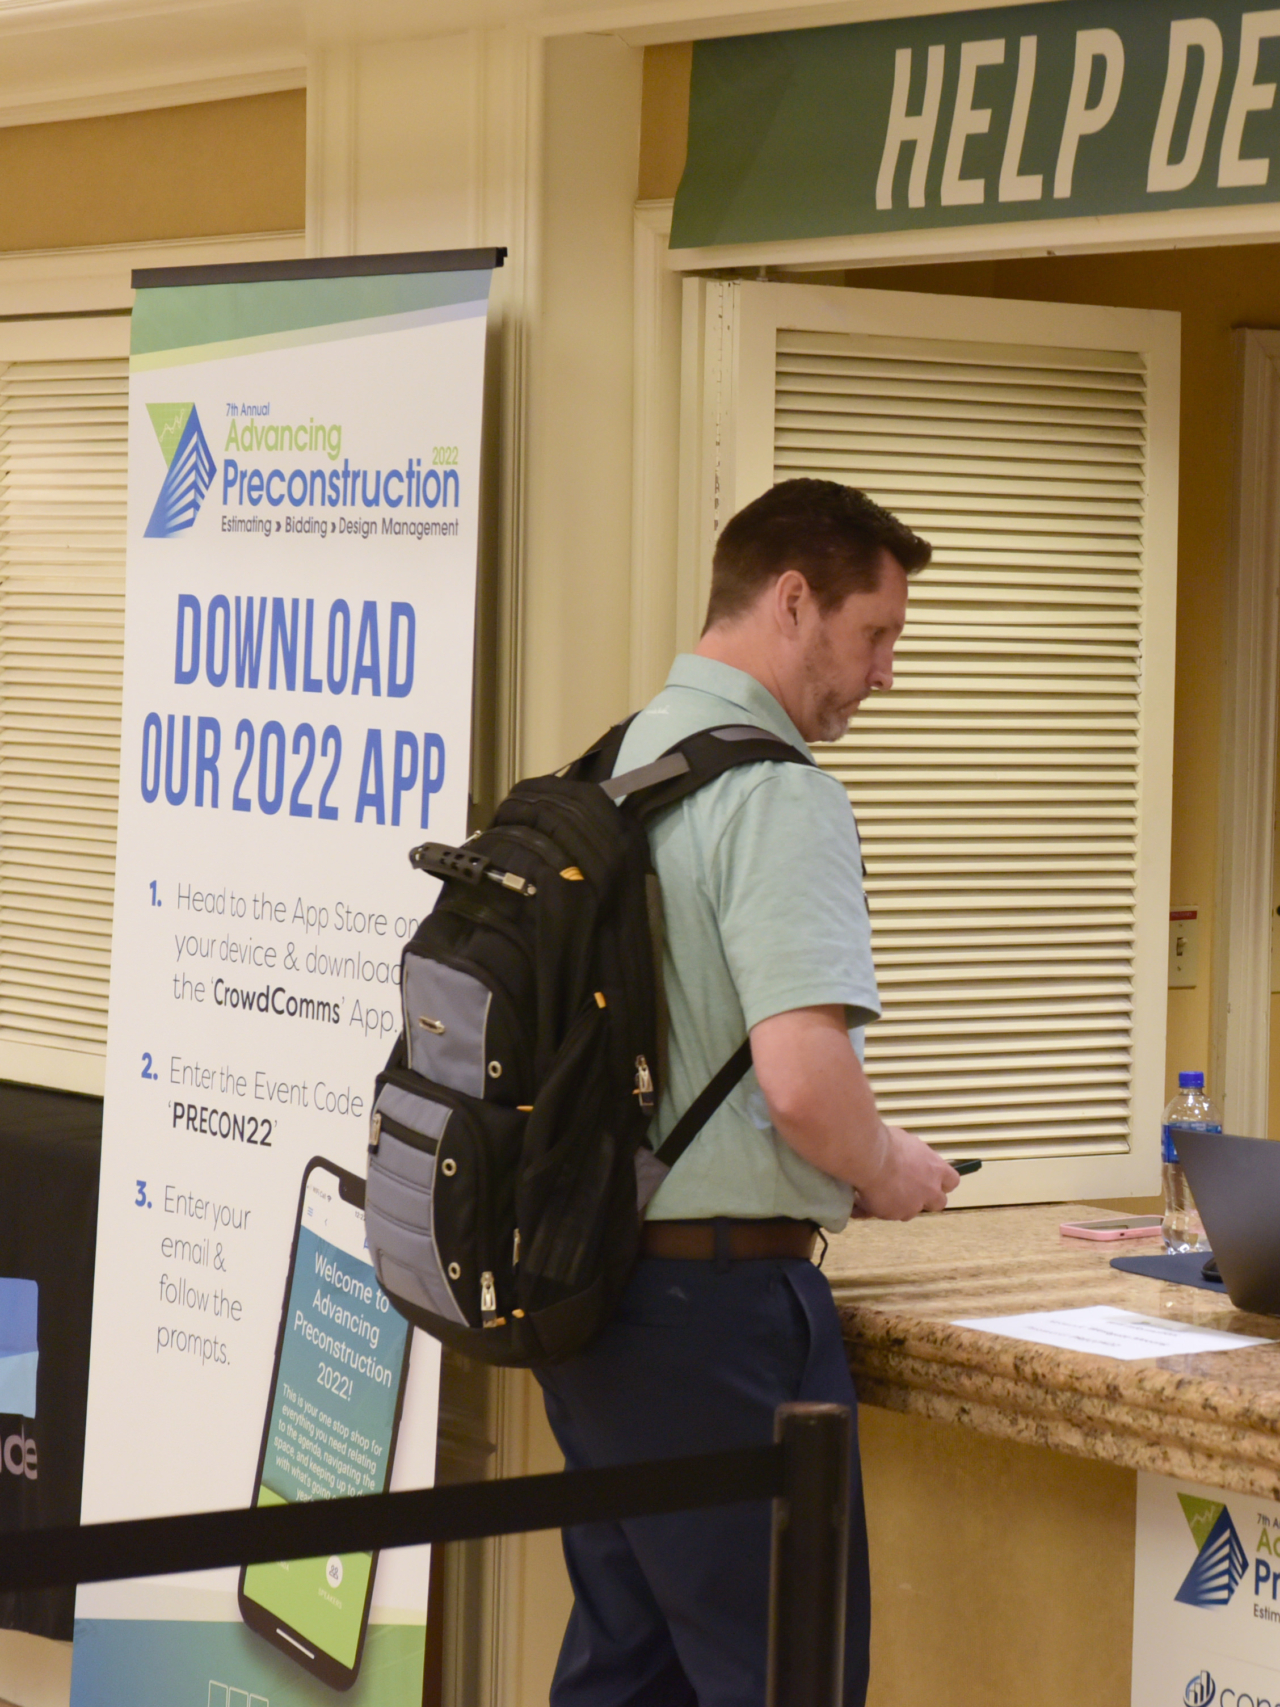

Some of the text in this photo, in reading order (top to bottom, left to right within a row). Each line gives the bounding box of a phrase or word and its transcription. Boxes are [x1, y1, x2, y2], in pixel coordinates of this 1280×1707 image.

[875, 27, 1126, 211] HELP
[225, 402, 270, 417] 7th Annual
[224, 417, 342, 461] Advancing
[432, 446, 459, 466] 2022
[222, 458, 460, 509] Preconstruction
[221, 515, 459, 541] Estimating Bidding Design Management
[174, 593, 416, 698] DOWNLOAD
[140, 711, 446, 830] OUR 2022 APP
[149, 880, 162, 908] 1.
[177, 882, 226, 912] Head
[230, 891, 247, 918] to
[252, 892, 287, 924] the
[292, 897, 329, 936] App
[333, 901, 388, 937] Store
[174, 933, 217, 963] your
[219, 933, 277, 969] device
[283, 941, 300, 972] &
[172, 972, 206, 1002] the
[349, 999, 398, 1040] App.
[141, 1052, 364, 1118] 2. Enter the Event Code
[134, 1179, 252, 1231] 3. Enter your
[161, 1236, 227, 1273] email &
[159, 1273, 243, 1322] follow the
[314, 1251, 390, 1313] Welcome to
[312, 1288, 380, 1349] Advancing
[156, 1325, 231, 1367] prompts.
[294, 1310, 393, 1388] Preconstruction
[316, 1362, 353, 1401] 2022!
[282, 1404, 377, 1475] everything you need relating
[283, 1383, 383, 1456] This is your one stop shop for
[275, 1455, 291, 1472] with
[278, 1418, 286, 1432] to
[286, 1424, 298, 1440] the
[323, 1451, 361, 1485] navigating
[362, 1473, 376, 1491] the
[296, 1451, 309, 1466] and
[309, 1458, 335, 1488] keeping
[336, 1479, 347, 1494] up
[348, 1483, 356, 1497] to
[1256, 1512, 1271, 1528] 7th
